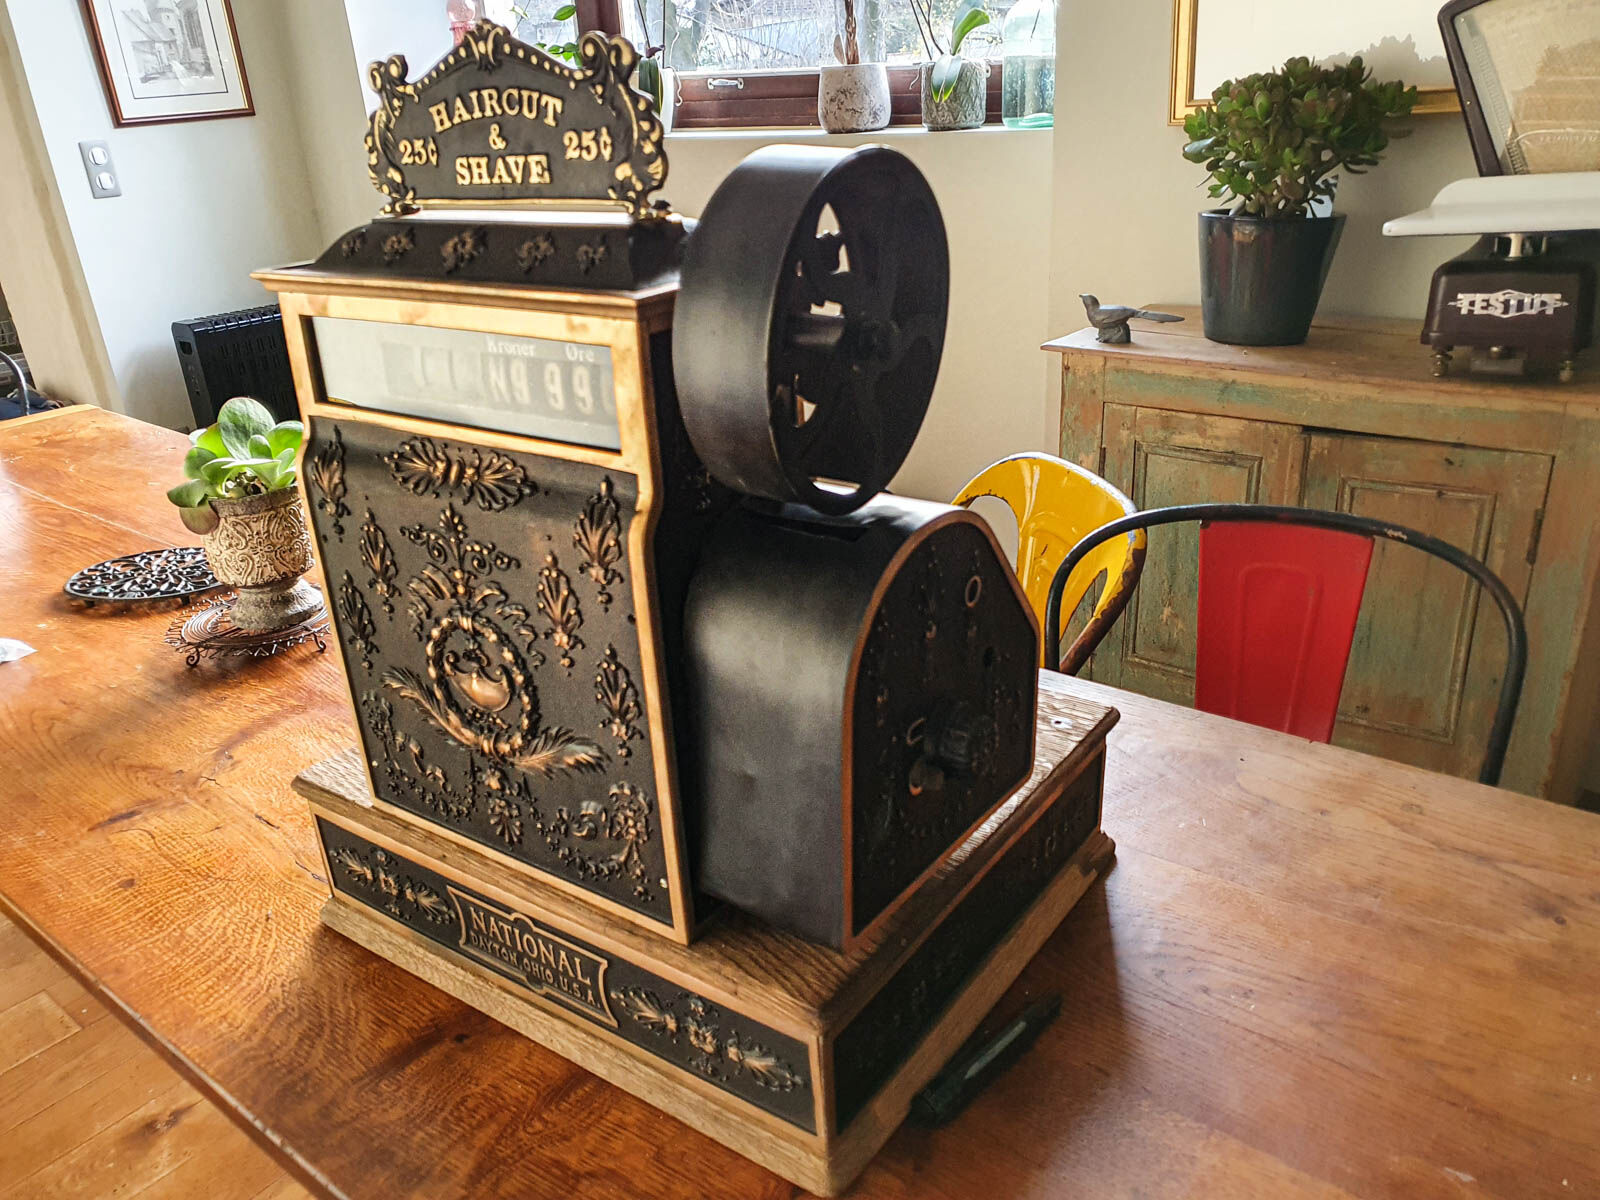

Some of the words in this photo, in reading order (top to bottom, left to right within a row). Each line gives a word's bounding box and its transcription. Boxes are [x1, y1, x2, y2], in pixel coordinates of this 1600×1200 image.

[429, 88, 563, 133] HAIRCUT
[399, 137, 439, 167] 25¢
[488, 123, 507, 150] &
[563, 126, 613, 161] 25¢
[455, 154, 551, 185] SHAVE
[486, 335, 536, 357] Kroner
[470, 906, 591, 985] NATIONAL
